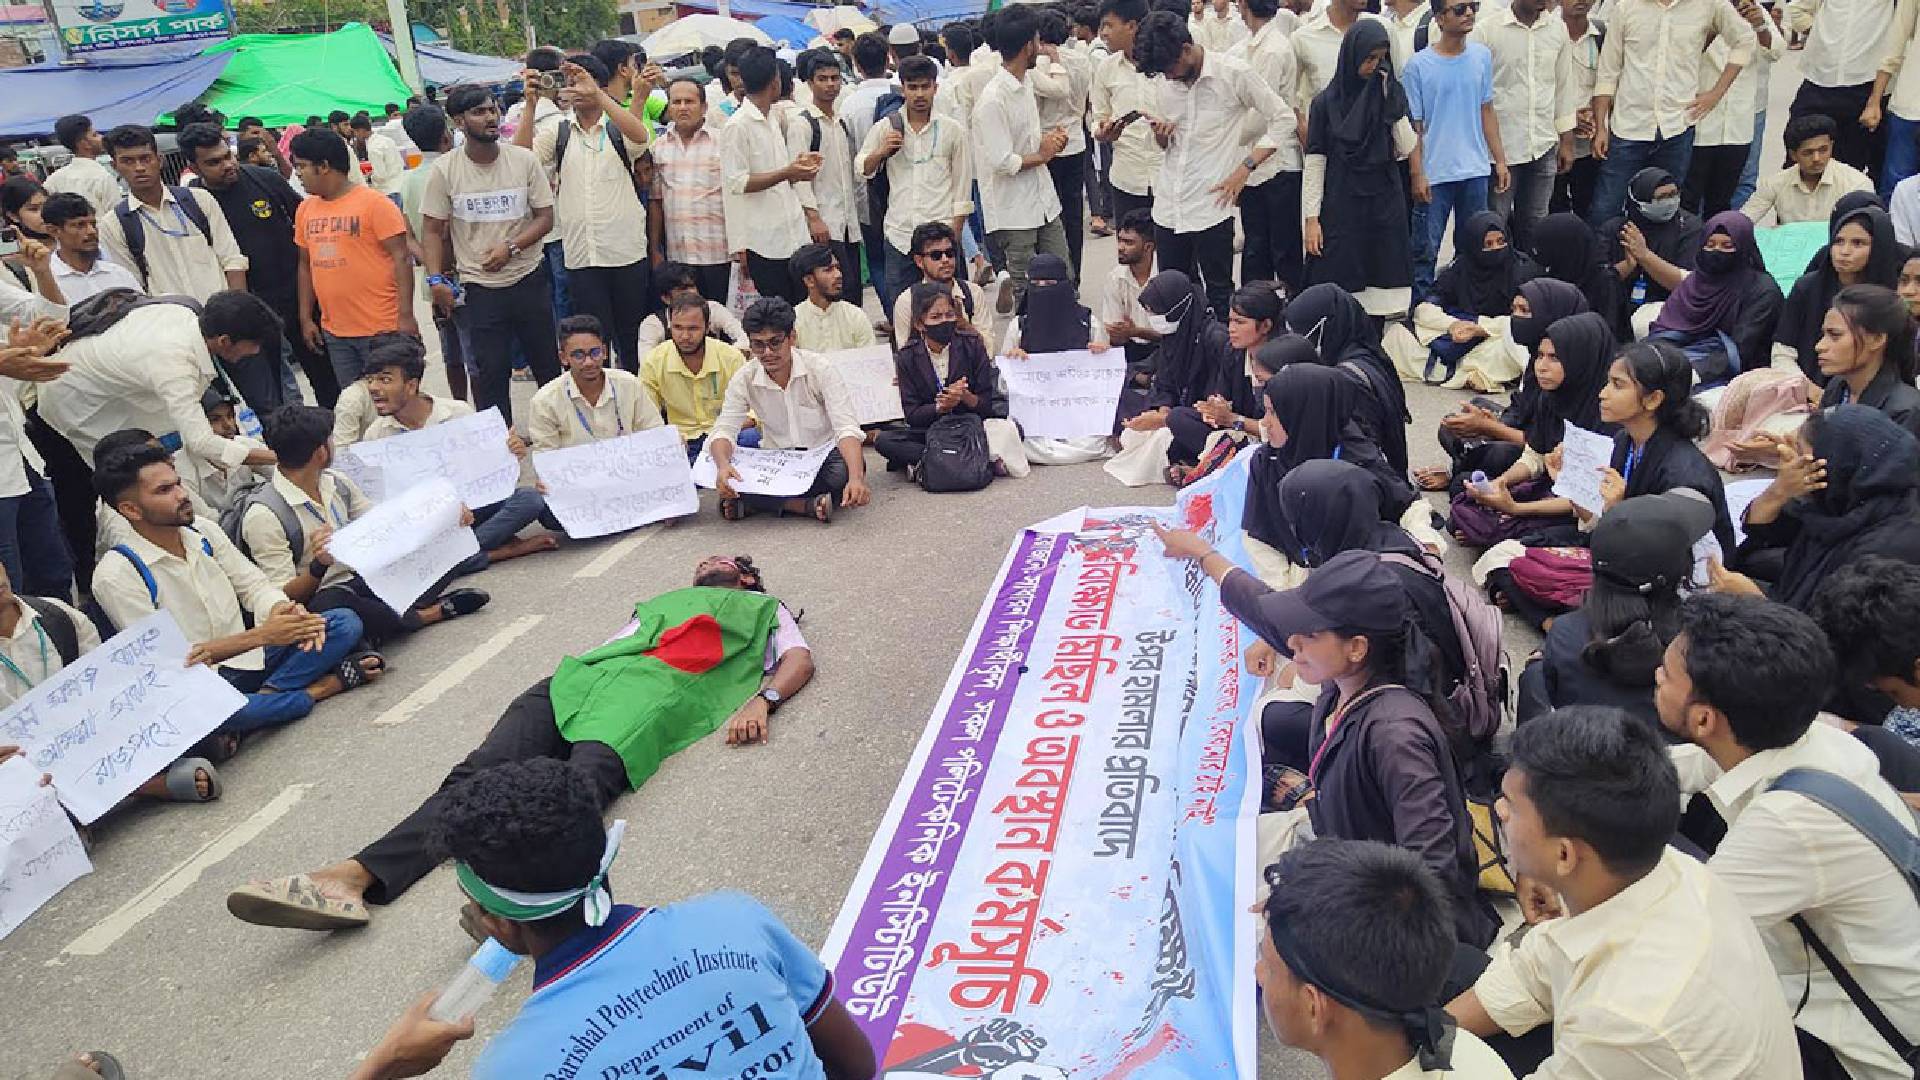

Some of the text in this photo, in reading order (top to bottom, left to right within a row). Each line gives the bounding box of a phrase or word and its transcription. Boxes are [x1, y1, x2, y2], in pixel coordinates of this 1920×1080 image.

[87, 18, 160, 43] নিসর্গ
[168, 12, 225, 32] পার্ক
[951, 700, 995, 742] সকল
[1093, 631, 1174, 859] উপর হামলার প্রতিবাদে
[904, 748, 982, 865] পলিটেকনিক
[924, 561, 1136, 1013] বিক্ষোভ মিছিল ও অবস্থান কর্মসূচি
[597, 956, 692, 1028] Polytechnic
[690, 944, 759, 974] Institute
[846, 871, 942, 1021] ইনস্টিটিউট
[600, 991, 735, 1080] Department of
